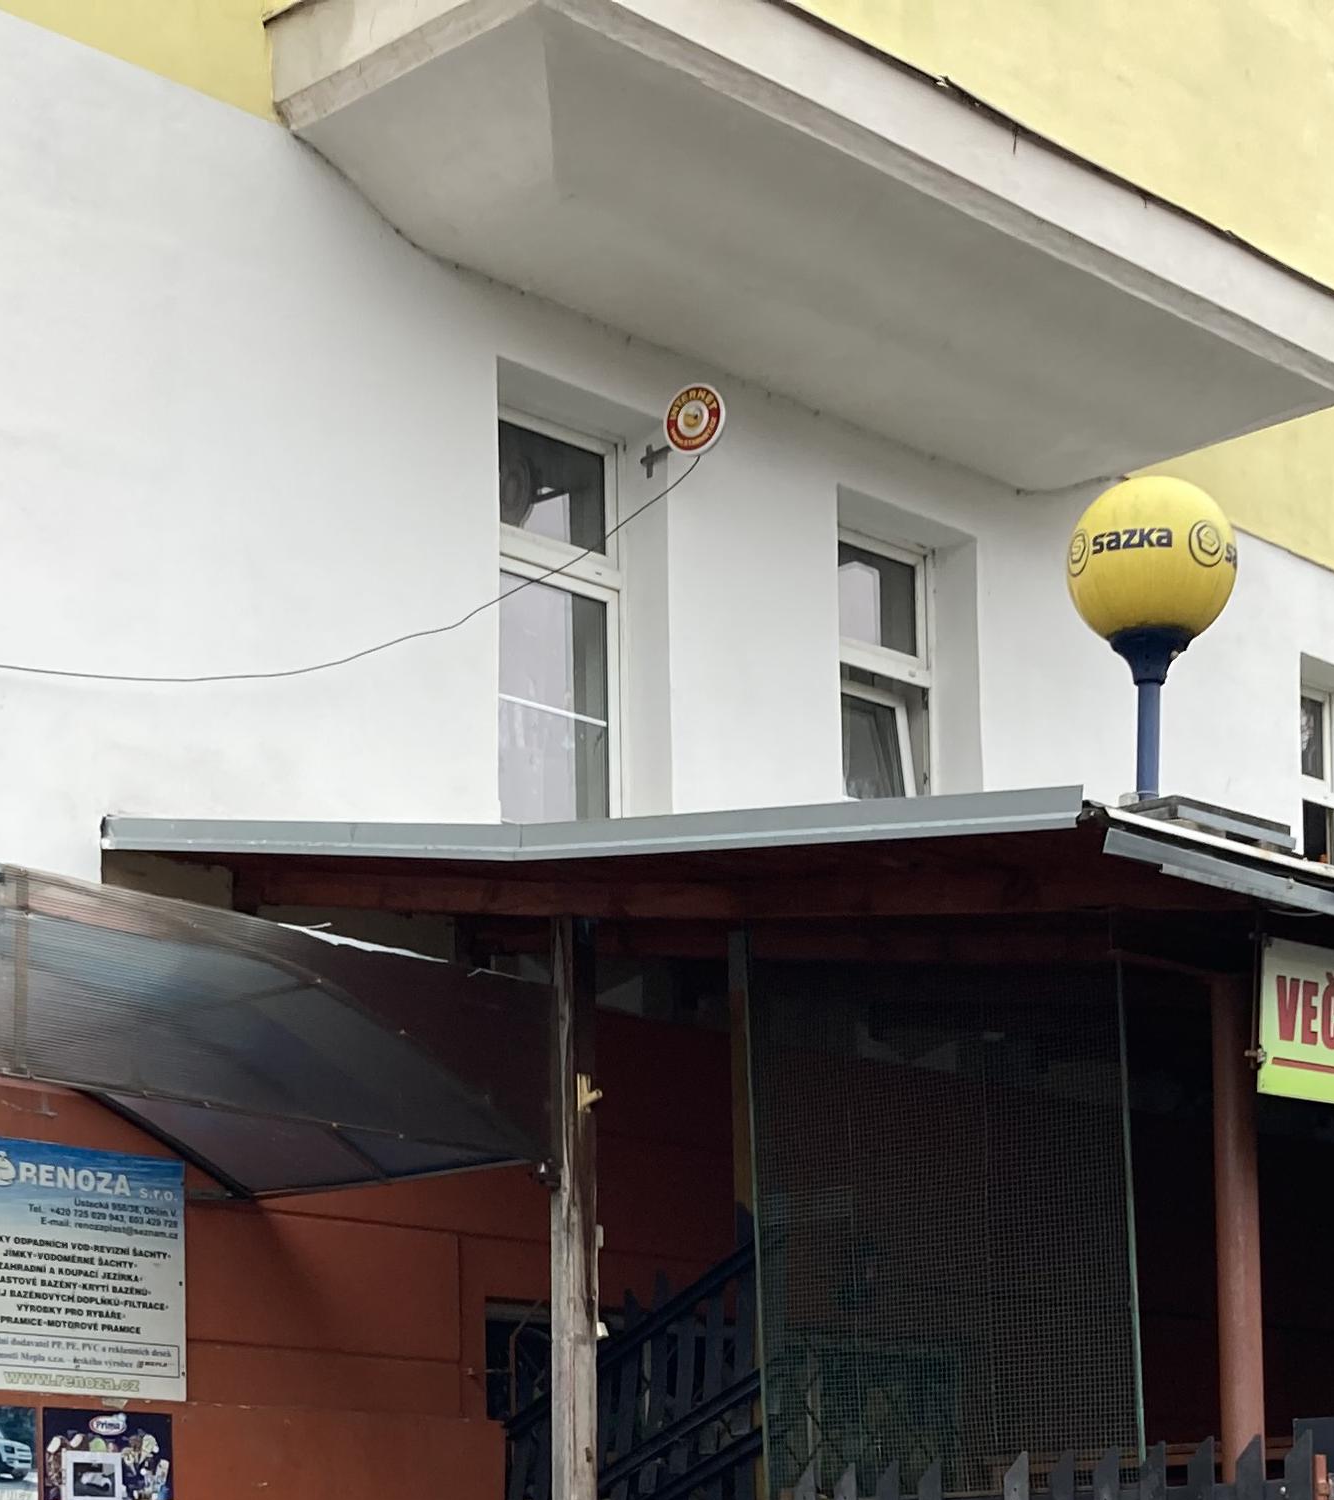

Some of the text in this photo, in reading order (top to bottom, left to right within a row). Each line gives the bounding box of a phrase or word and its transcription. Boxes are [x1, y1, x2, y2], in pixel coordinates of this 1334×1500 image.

[669, 389, 718, 419] INTERNET
[18, 1162, 178, 1201] RENOZA s.r.o.
[13, 1236, 68, 1249] ODPADNÍCH
[58, 1268, 98, 1278] KOUPACÍ
[10, 1289, 75, 1302] BAZÉNOVÝCH
[16, 1303, 62, 1315] VÝROBKY
[65, 1307, 84, 1317] PRO
[101, 1323, 141, 1335] PRAMICE
[4, 1371, 140, 1392] www.renoza.cz
[95, 1421, 121, 1430] Prima
